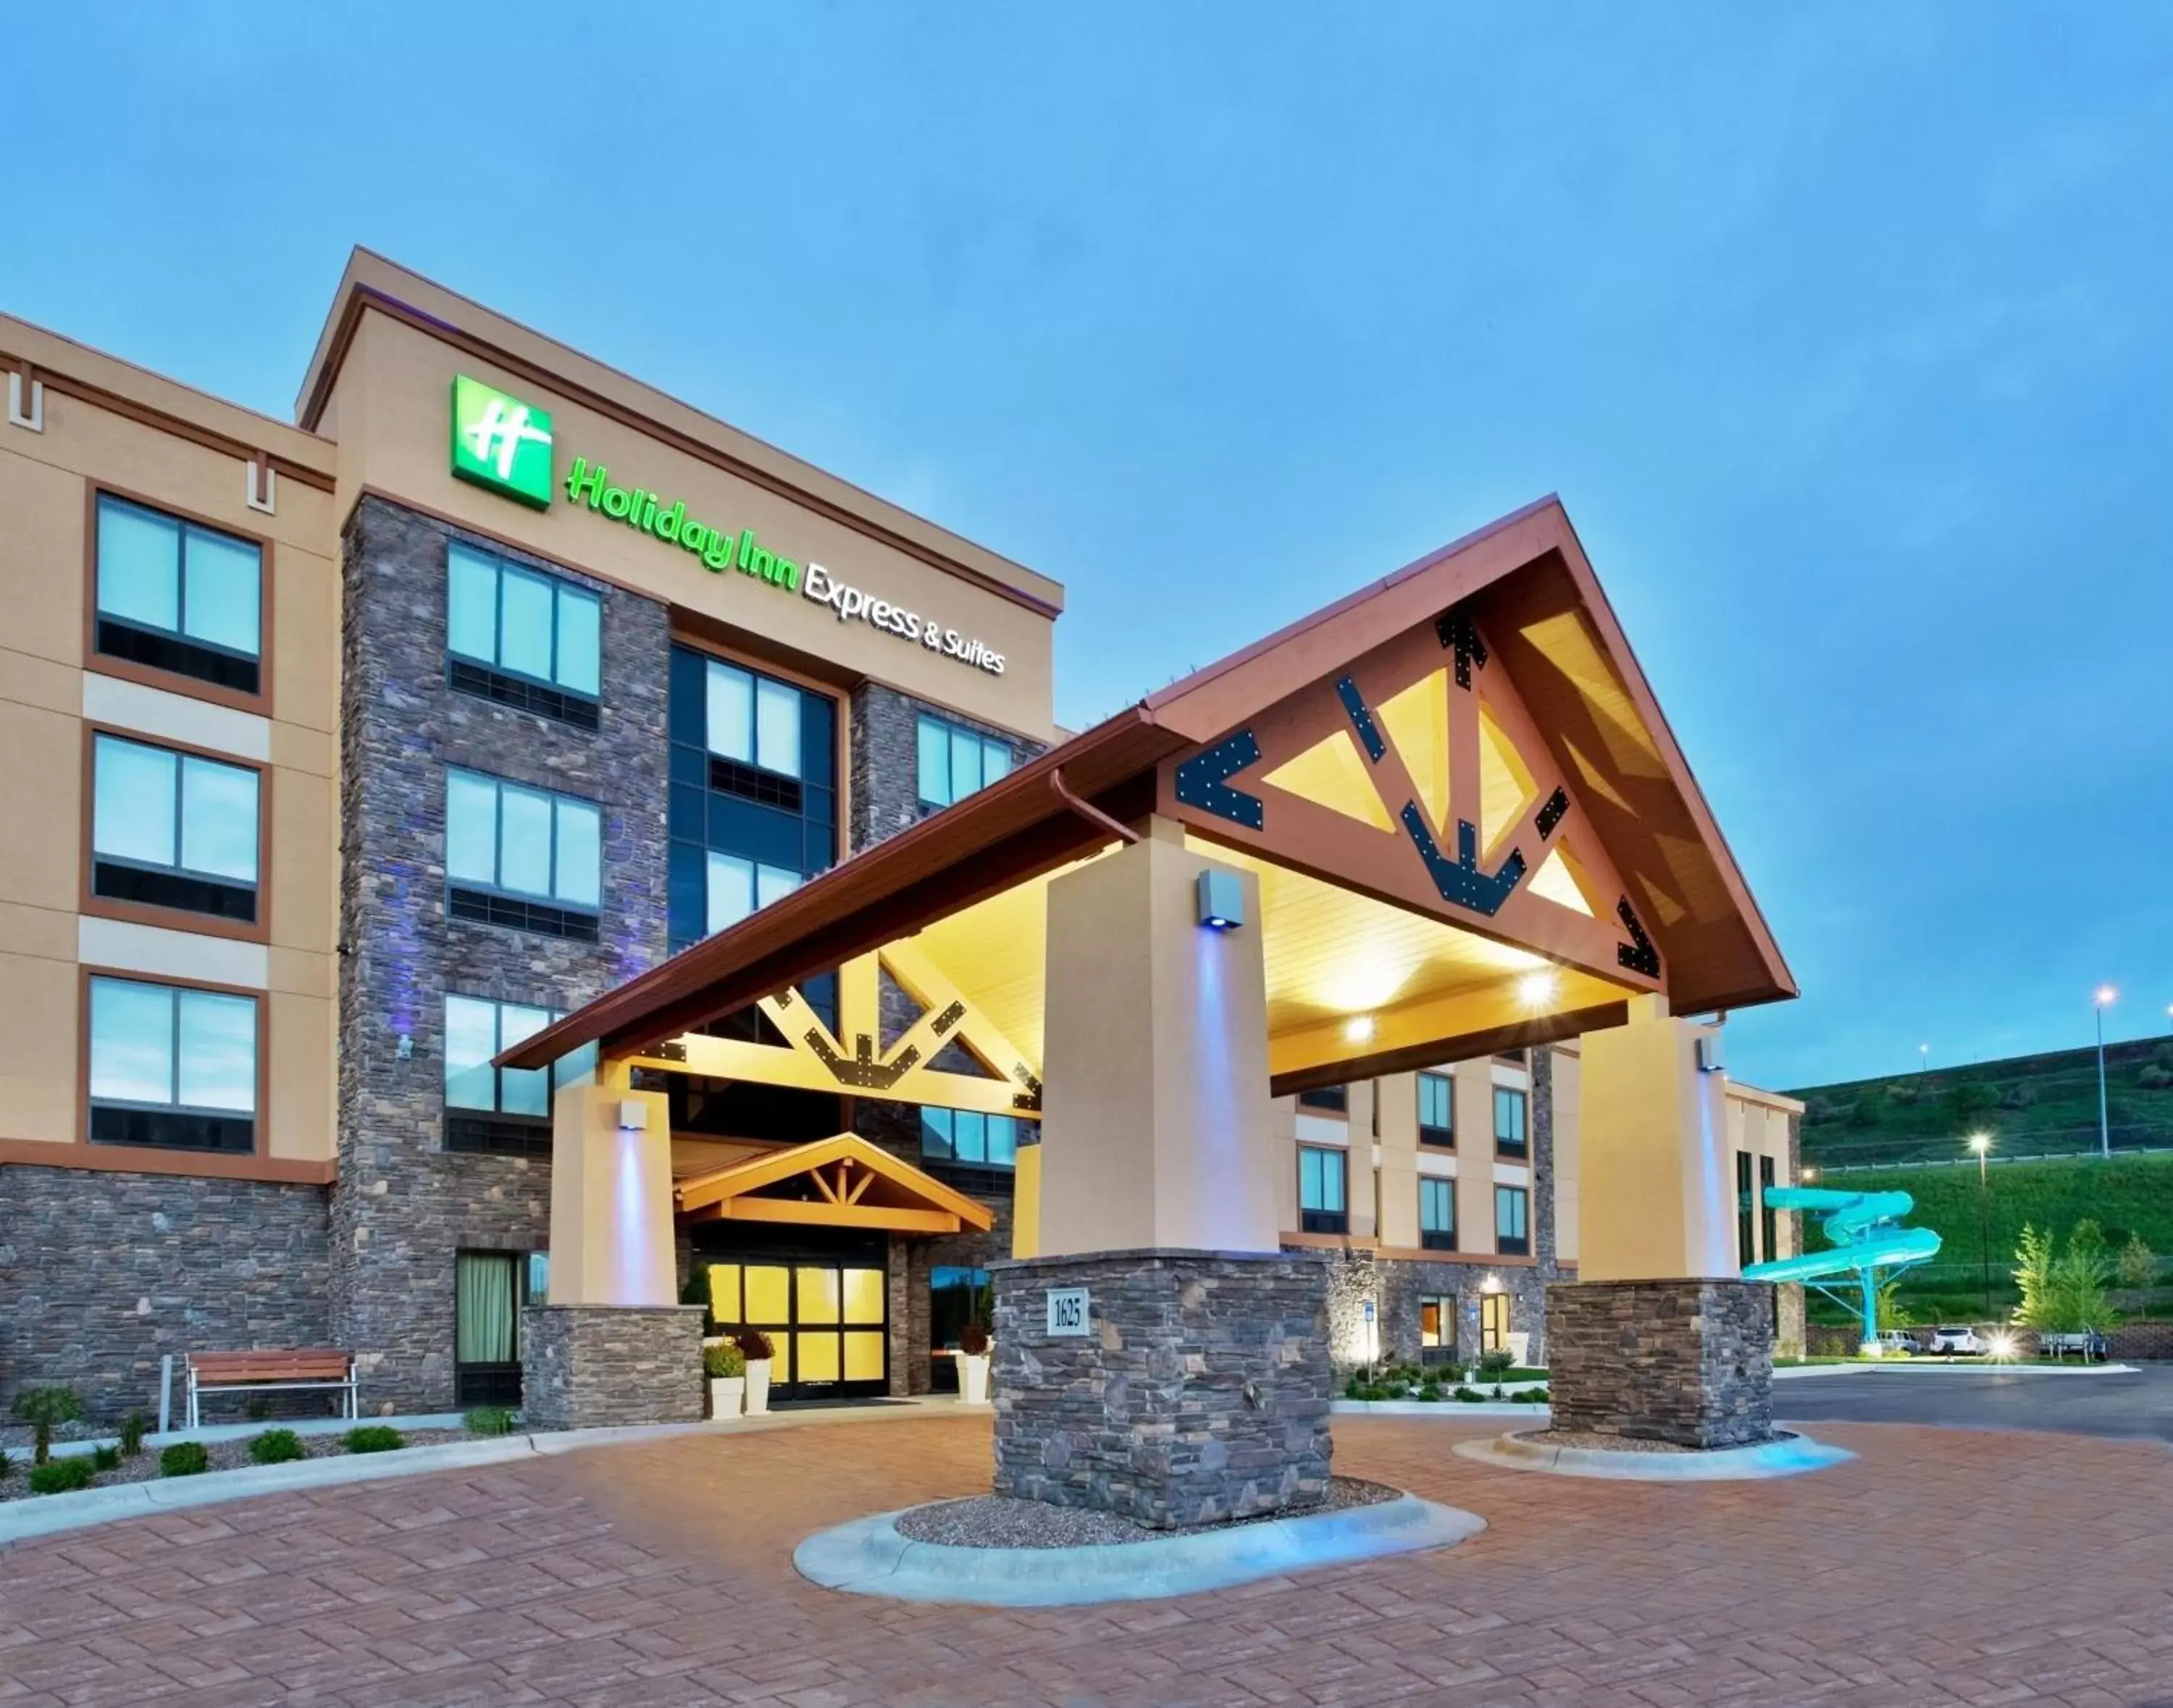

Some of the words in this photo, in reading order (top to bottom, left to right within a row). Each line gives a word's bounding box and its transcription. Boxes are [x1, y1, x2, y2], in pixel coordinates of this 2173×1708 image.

[465, 398, 551, 480] H
[566, 458, 733, 570] Holiday
[738, 530, 797, 591] Inn
[803, 563, 920, 639] Express
[924, 621, 941, 648] &
[944, 629, 1005, 674] Suites
[1055, 1297, 1080, 1327] 1625
